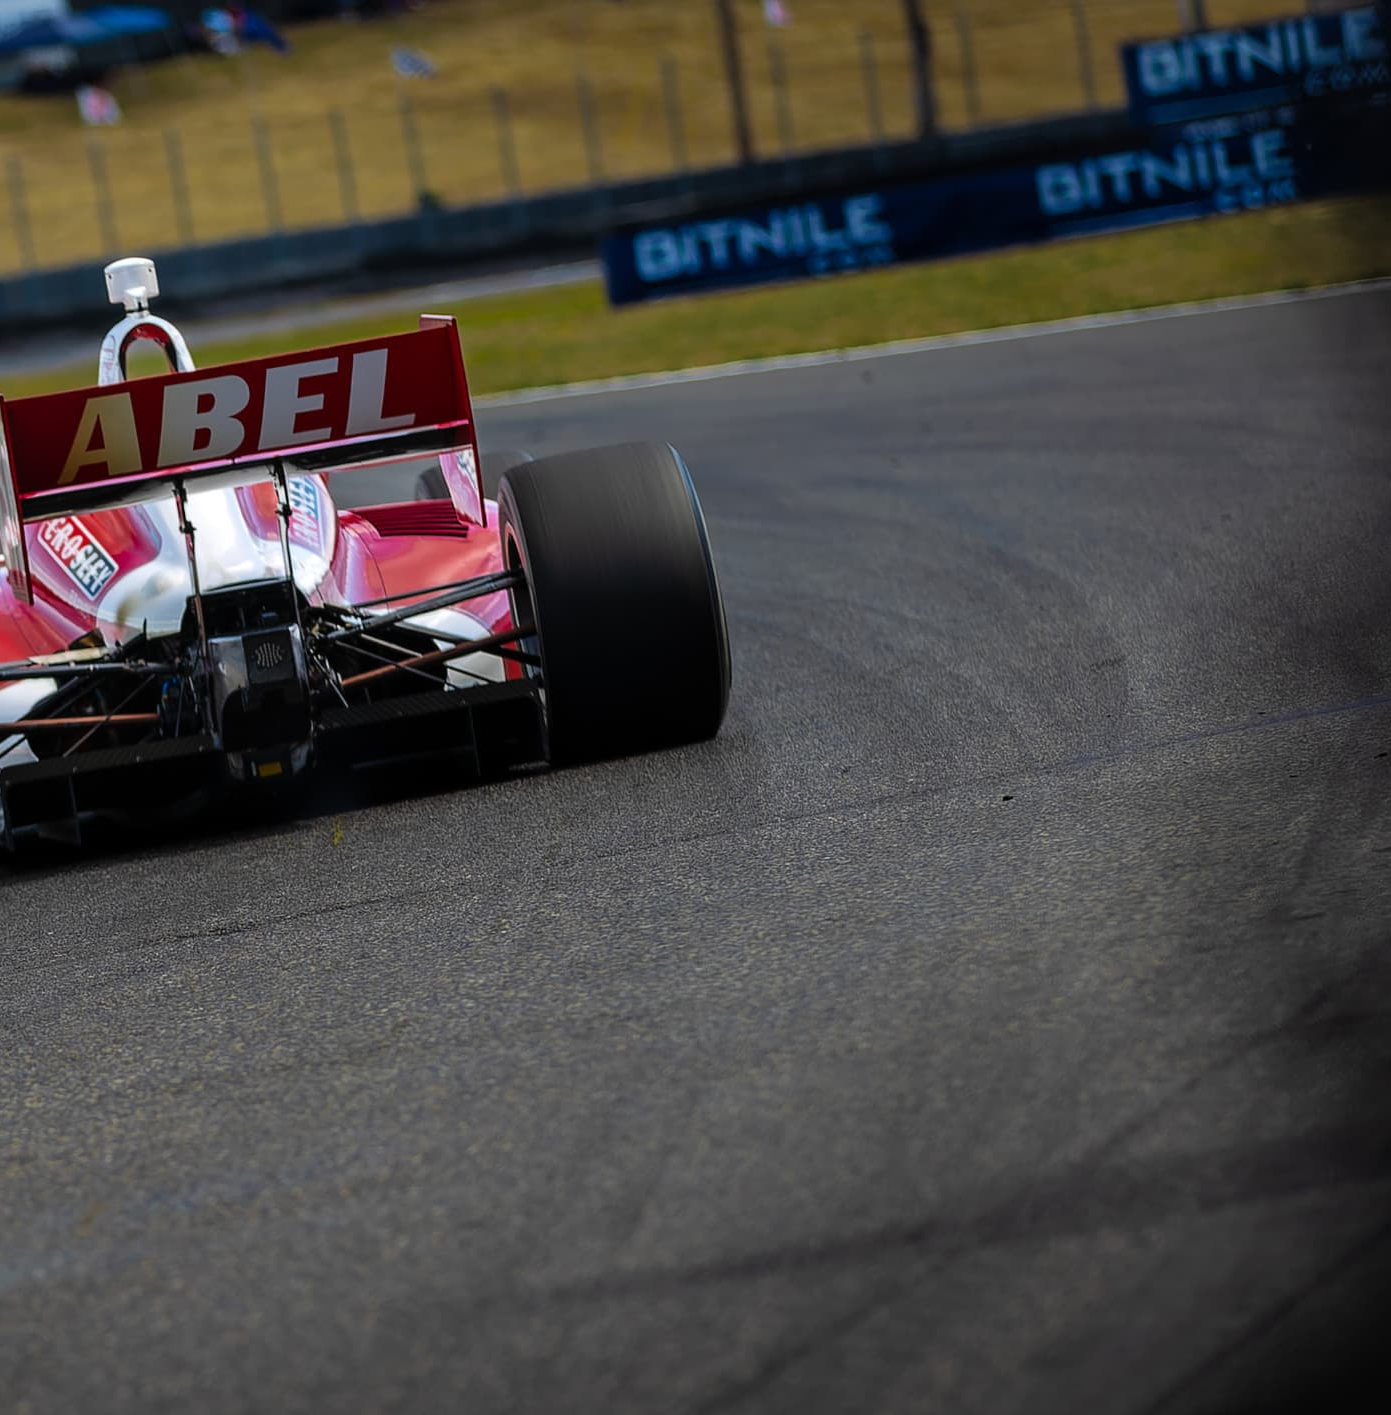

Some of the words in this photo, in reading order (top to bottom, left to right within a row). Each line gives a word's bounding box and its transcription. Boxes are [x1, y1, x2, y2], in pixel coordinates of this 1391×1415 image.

[1136, 6, 1386, 97] BITNILE
[1035, 129, 1295, 215] BITNILE
[633, 192, 893, 281] BITNILE
[57, 348, 416, 484] ABEL
[43, 516, 113, 593] CROSLEY
